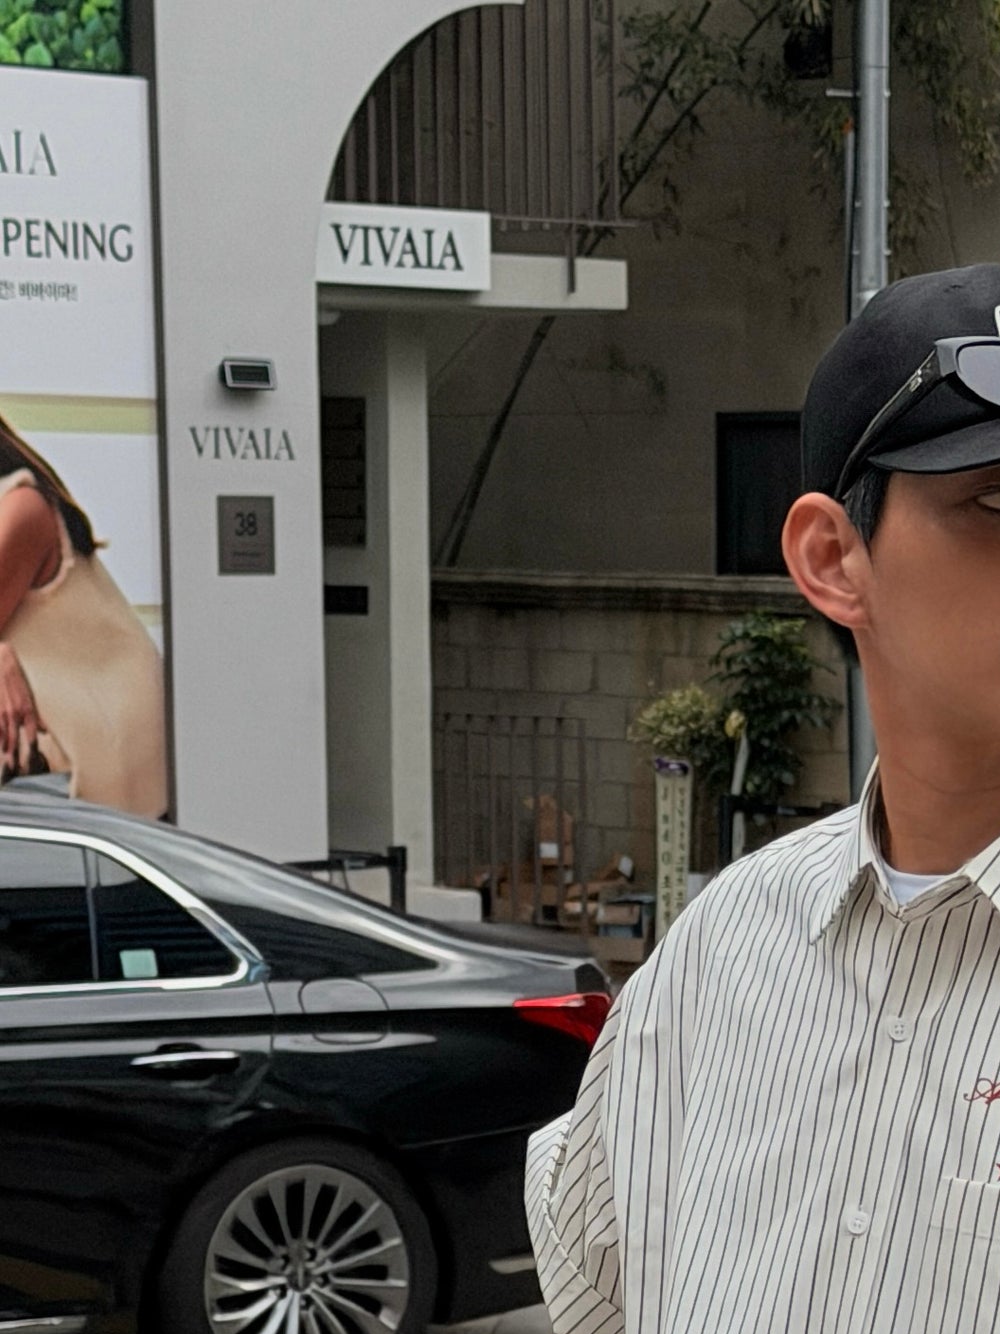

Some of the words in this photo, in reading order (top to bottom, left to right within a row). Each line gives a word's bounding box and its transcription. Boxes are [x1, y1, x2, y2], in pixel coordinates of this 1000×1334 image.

[330, 223, 464, 271] VIVAIA
[189, 426, 296, 461] VIVAIA
[234, 512, 258, 536] 38
